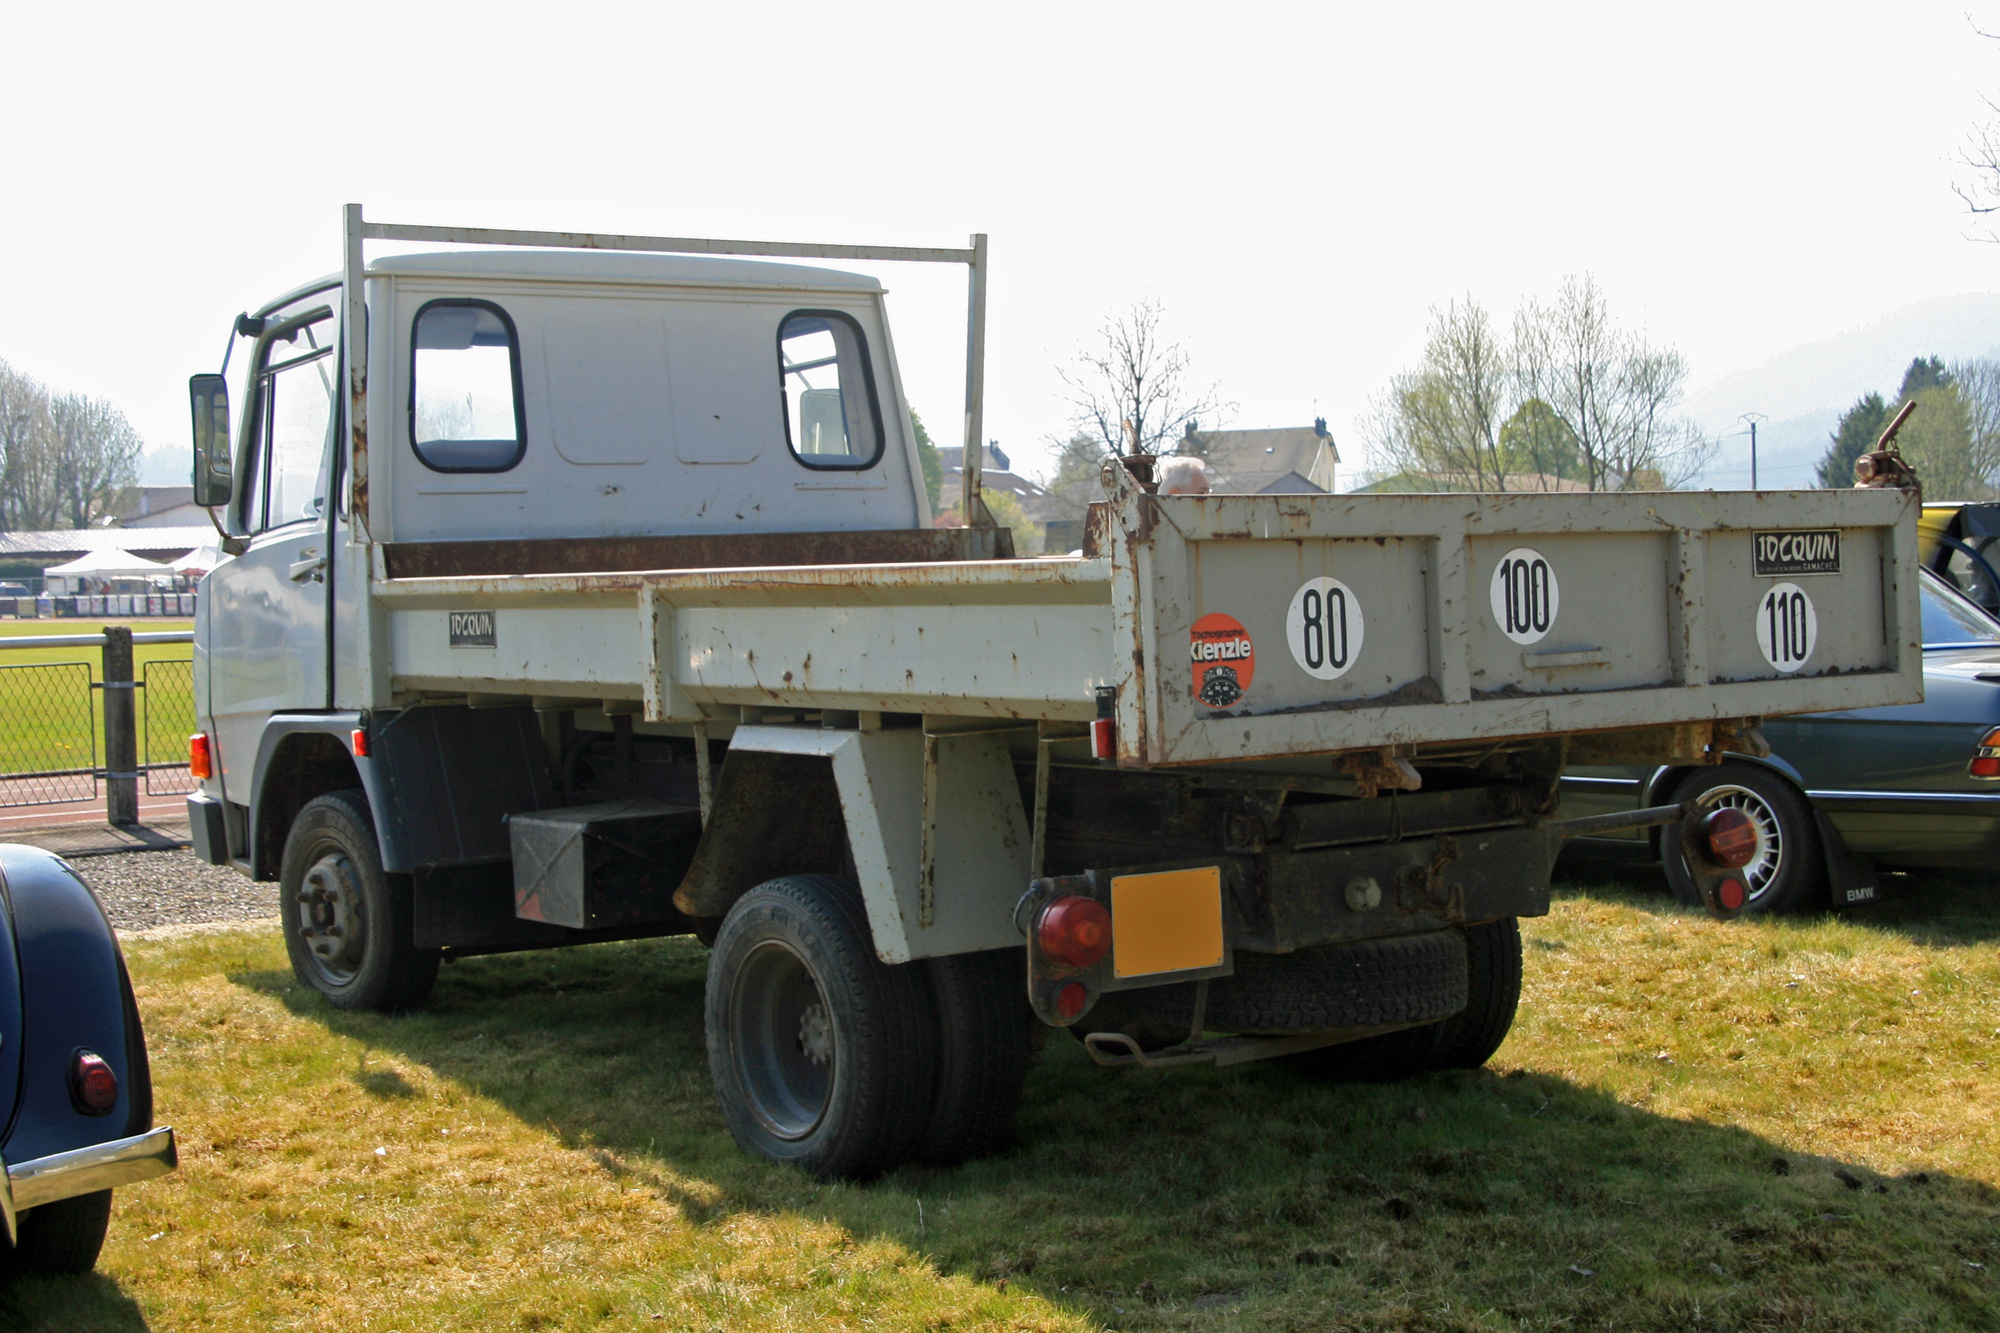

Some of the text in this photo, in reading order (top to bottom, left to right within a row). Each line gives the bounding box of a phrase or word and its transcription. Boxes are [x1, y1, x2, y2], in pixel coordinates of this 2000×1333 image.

[1758, 534, 1836, 562] JOCQUIN
[1802, 562, 1838, 571] GAMACHES
[1500, 559, 1549, 634] 100
[451, 614, 492, 636] JOCQUIN
[1191, 629, 1244, 639] Tachographe
[1303, 587, 1348, 669] 80
[1765, 591, 1807, 662] 110
[1846, 887, 1874, 901] BMW
